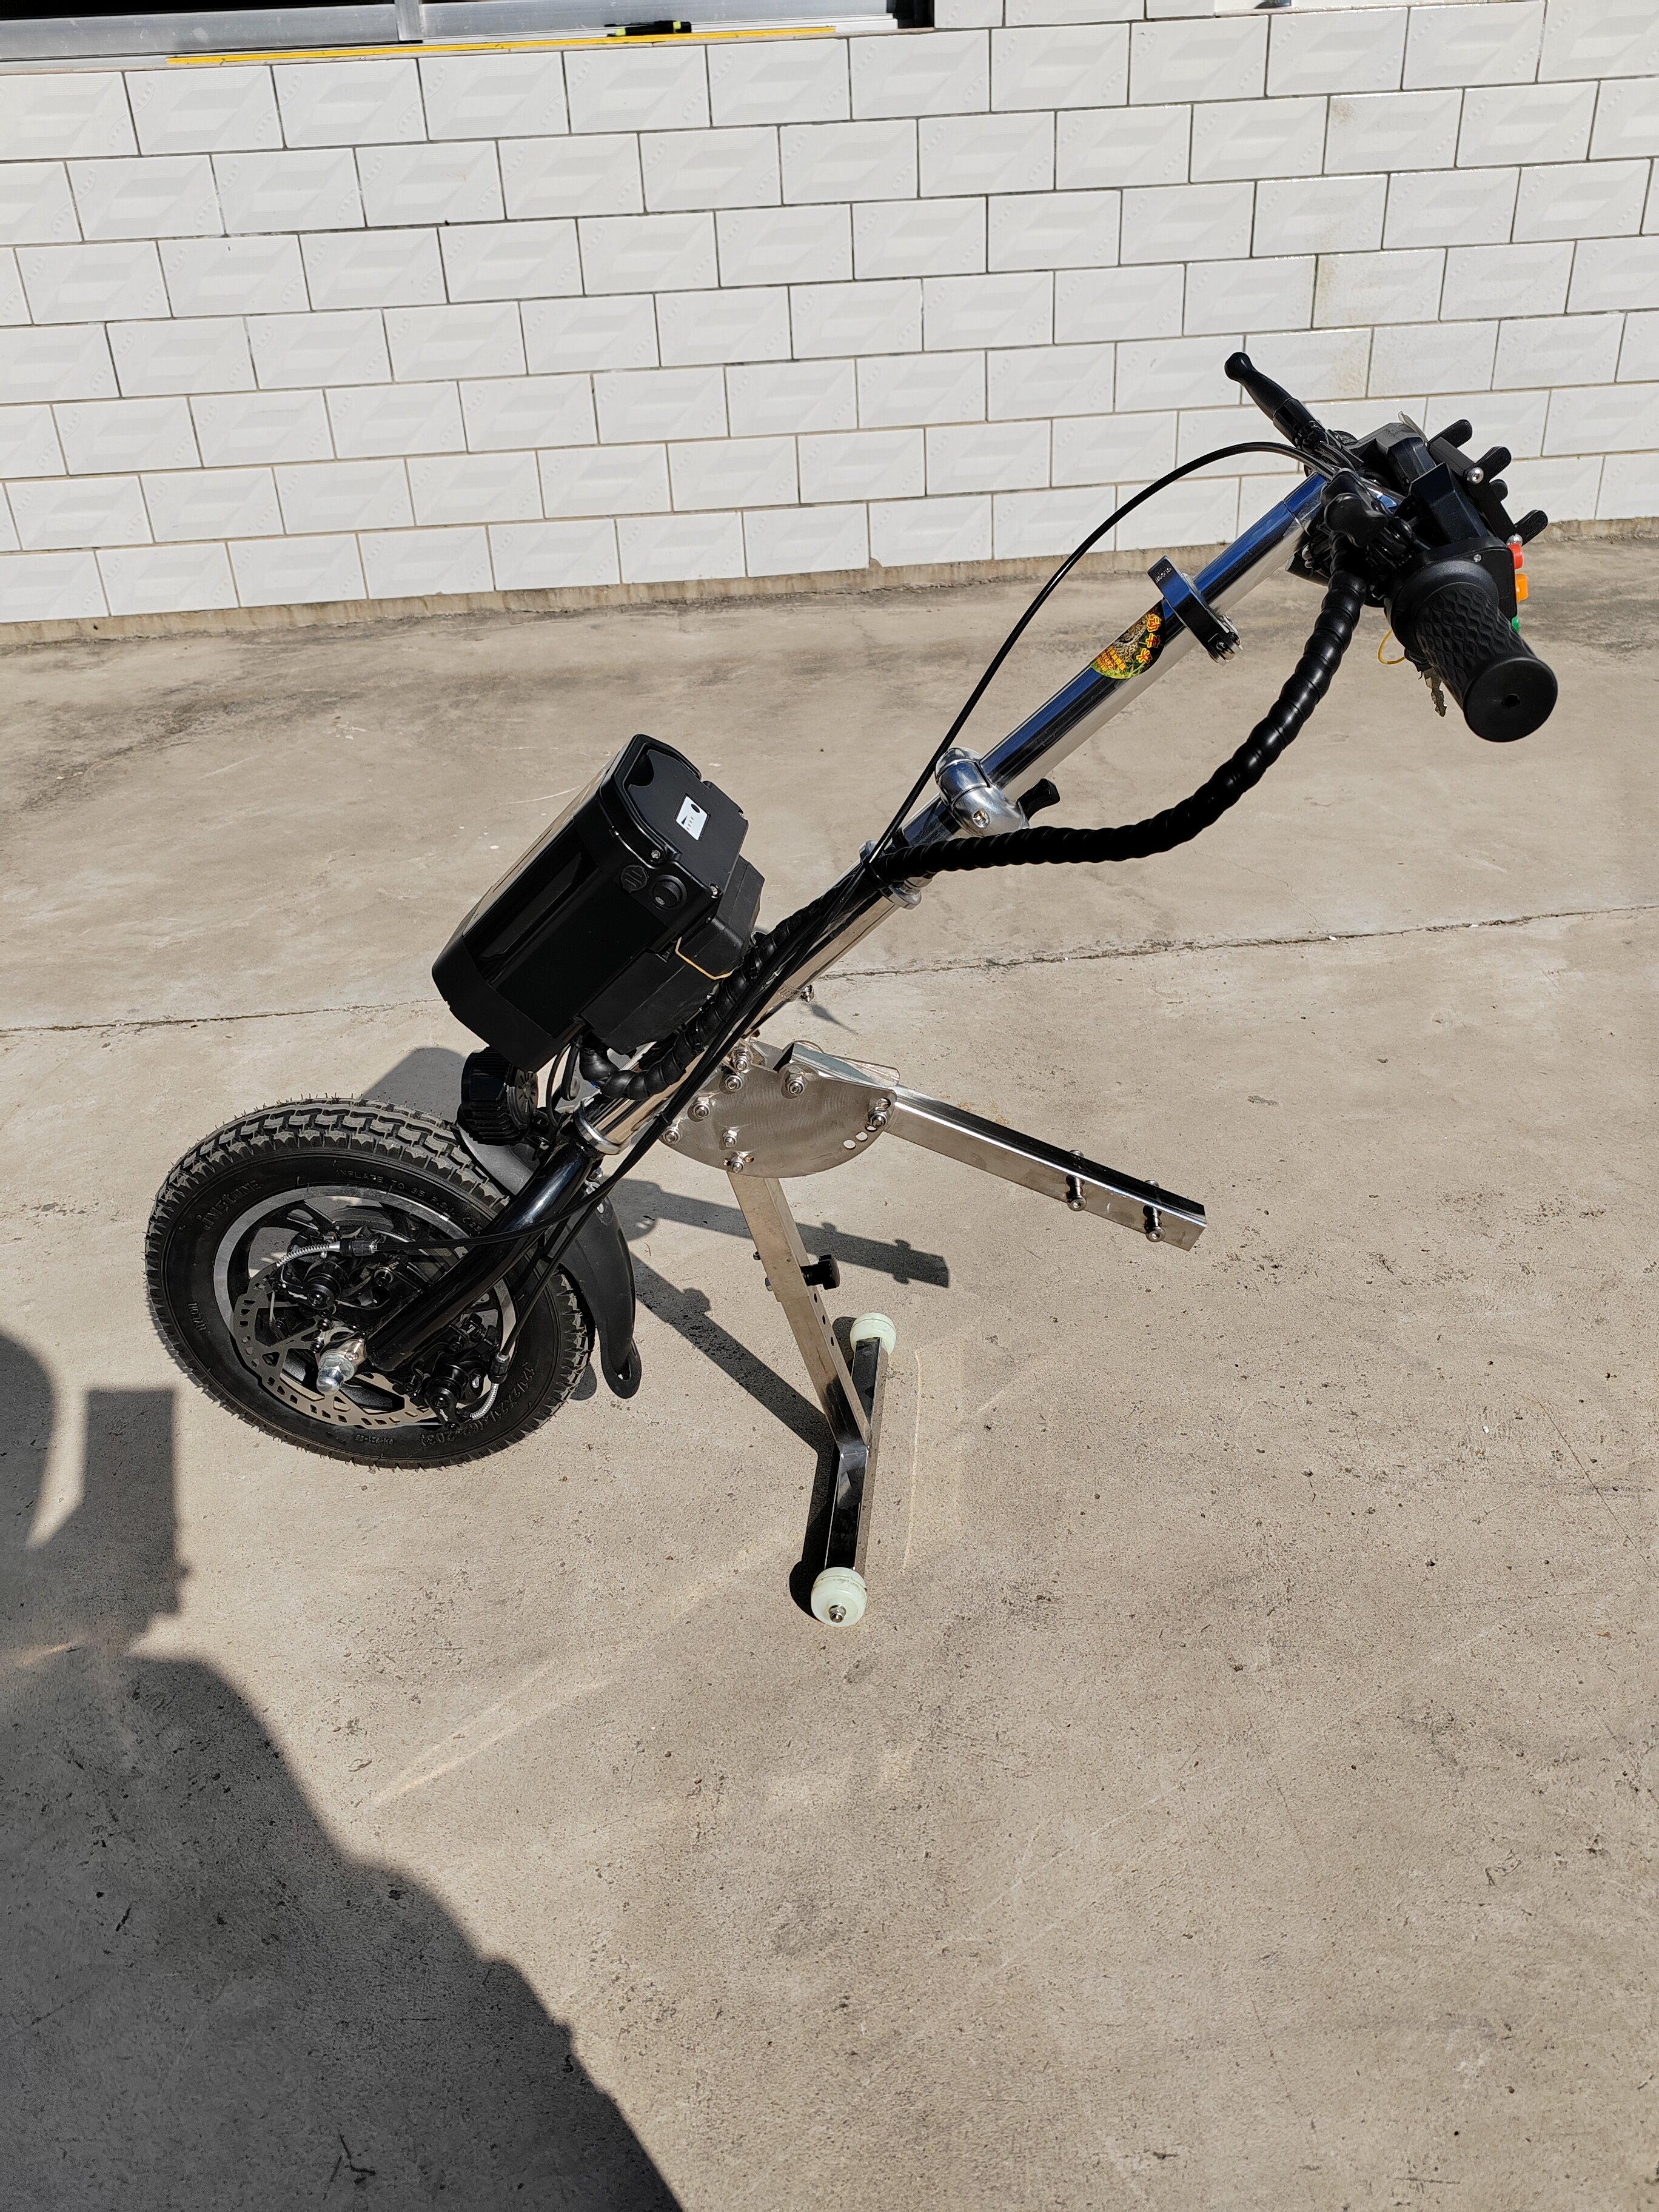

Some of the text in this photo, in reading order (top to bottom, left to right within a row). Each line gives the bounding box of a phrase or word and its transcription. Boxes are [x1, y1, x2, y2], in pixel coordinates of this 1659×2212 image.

[335, 1169, 384, 1183] INFLATE
[390, 1179, 405, 1190] TO
[411, 1186, 426, 1197] 35
[187, 1302, 207, 1331] NYLON
